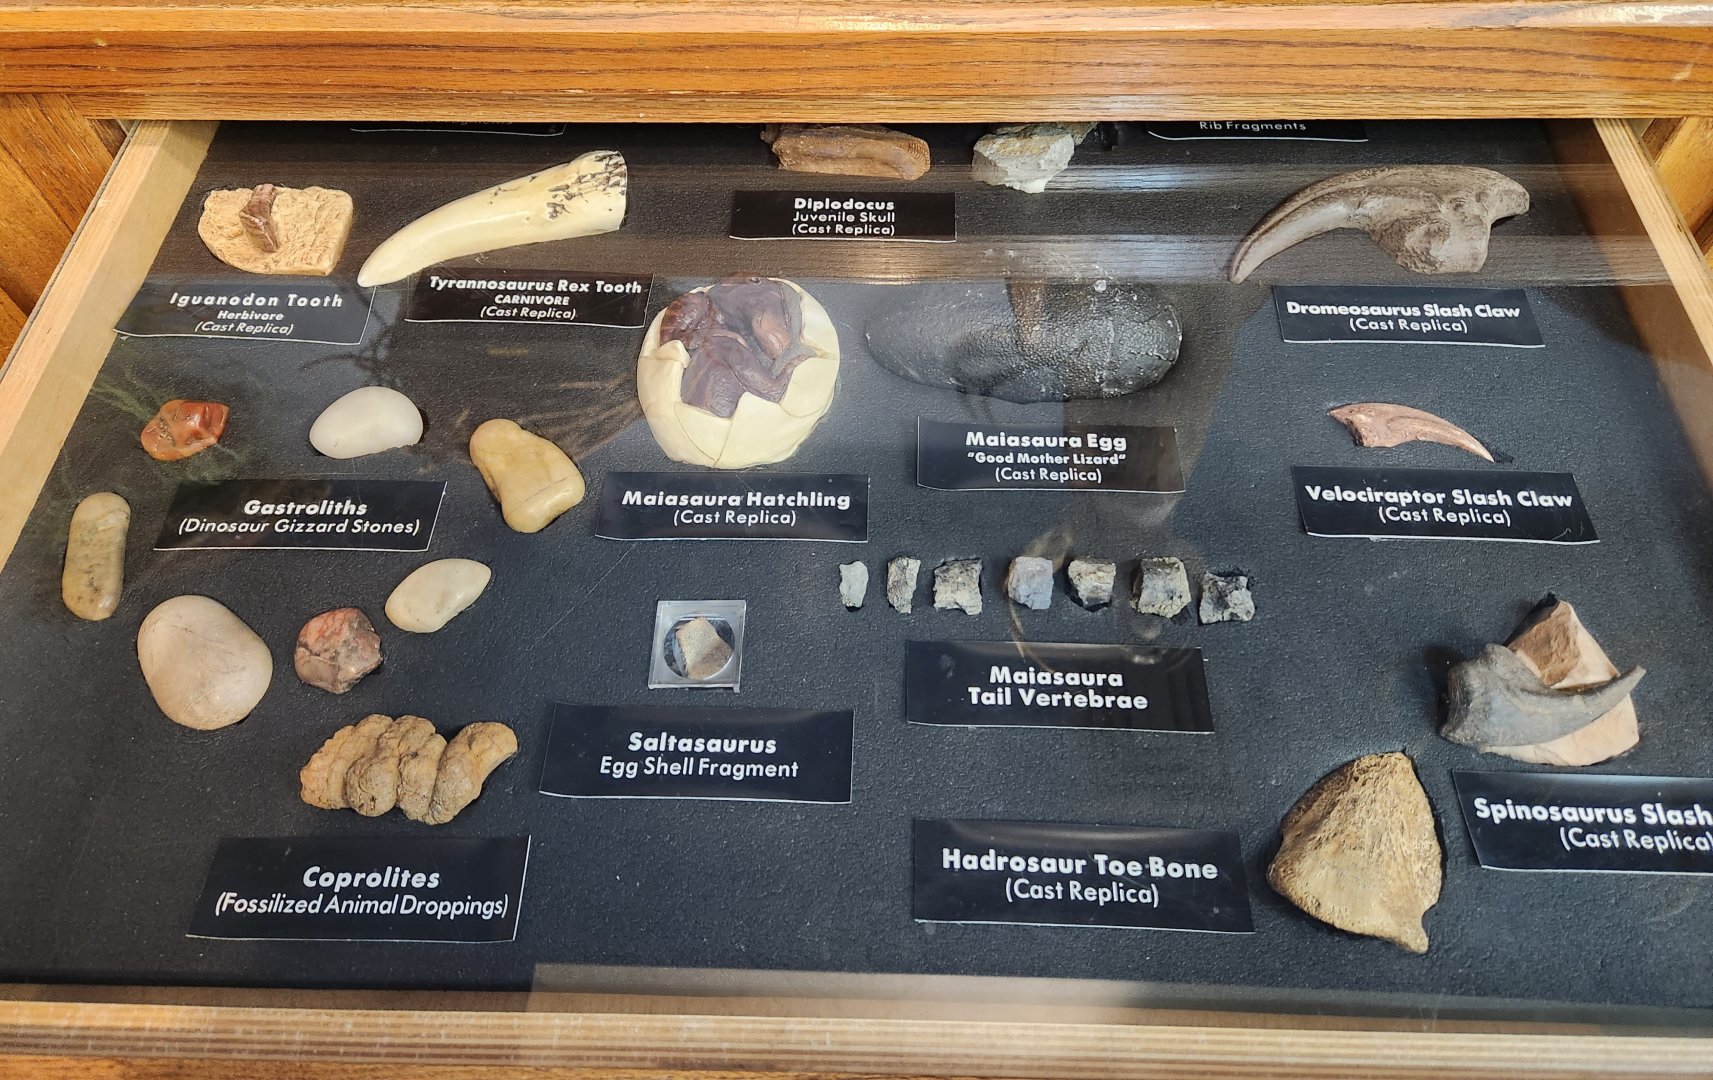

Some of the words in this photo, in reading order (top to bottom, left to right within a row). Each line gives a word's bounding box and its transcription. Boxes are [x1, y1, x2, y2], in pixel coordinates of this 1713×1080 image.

[1199, 121, 1222, 130] Rib
[1226, 121, 1307, 132] Fragments
[794, 197, 895, 212] Diplodocus
[792, 211, 855, 222] Juvenile
[859, 211, 896, 223] Skull
[791, 223, 831, 235] (Cast
[835, 224, 895, 236] Replica)
[429, 276, 554, 291] Tyrannosaurus
[558, 279, 589, 293] Rex
[595, 280, 642, 294] Tooth
[170, 292, 279, 308] Iguanodon
[287, 293, 343, 307] Tooth
[494, 294, 570, 306] CARNIVORE
[216, 310, 284, 321] Herbivore
[480, 306, 518, 318] (Cast
[519, 308, 576, 320] Replica)
[1286, 301, 1421, 317] Dromeosaurus
[1423, 303, 1473, 318] Slash
[1474, 304, 1521, 318] Claw
[194, 321, 235, 332] (Cast
[236, 323, 294, 335] Replica)
[1349, 318, 1394, 332] (Cast
[1399, 319, 1468, 334] Replica)
[965, 431, 1082, 447] Maiasaura
[1086, 433, 1127, 451] Egg
[1017, 452, 1069, 464] Mother
[994, 467, 1036, 482] (Cast
[1039, 467, 1102, 484] Replica)
[621, 490, 741, 506] Maiasaura
[746, 492, 850, 510] Hatchling
[1304, 485, 1446, 507] Velociraptor
[1451, 488, 1512, 507] Slash
[1516, 490, 1573, 507] Claw
[243, 499, 368, 516] Gastroliths
[673, 509, 720, 526] (Cast
[725, 510, 797, 527] Replica)
[1378, 506, 1428, 523] (Cast
[1434, 508, 1511, 528] Replica)
[178, 518, 269, 535] (Dinosaur
[274, 518, 349, 534] Gizzard
[351, 518, 420, 536] Stones)
[989, 665, 1123, 687] Maiasaura
[967, 686, 1012, 706] Tail
[1018, 688, 1149, 710] Vertebrae
[627, 732, 777, 754] Saltasaurus
[599, 756, 639, 779] Egg
[643, 756, 694, 776] Shell
[698, 757, 799, 781] Fragment
[1473, 797, 1637, 824] Spinosaurus
[1640, 803, 1713, 826] Slash
[1559, 827, 1620, 852] (Cast
[942, 848, 1087, 875] Hadrosaur
[1093, 854, 1143, 877] Toe
[1148, 856, 1219, 880] Bone
[302, 866, 440, 892] Coprolites
[1005, 877, 1063, 903] (Cast
[1069, 880, 1159, 908] Replica)
[214, 891, 322, 916] (Fossilized
[323, 894, 399, 915] Animal
[400, 894, 509, 920] Droppings)
